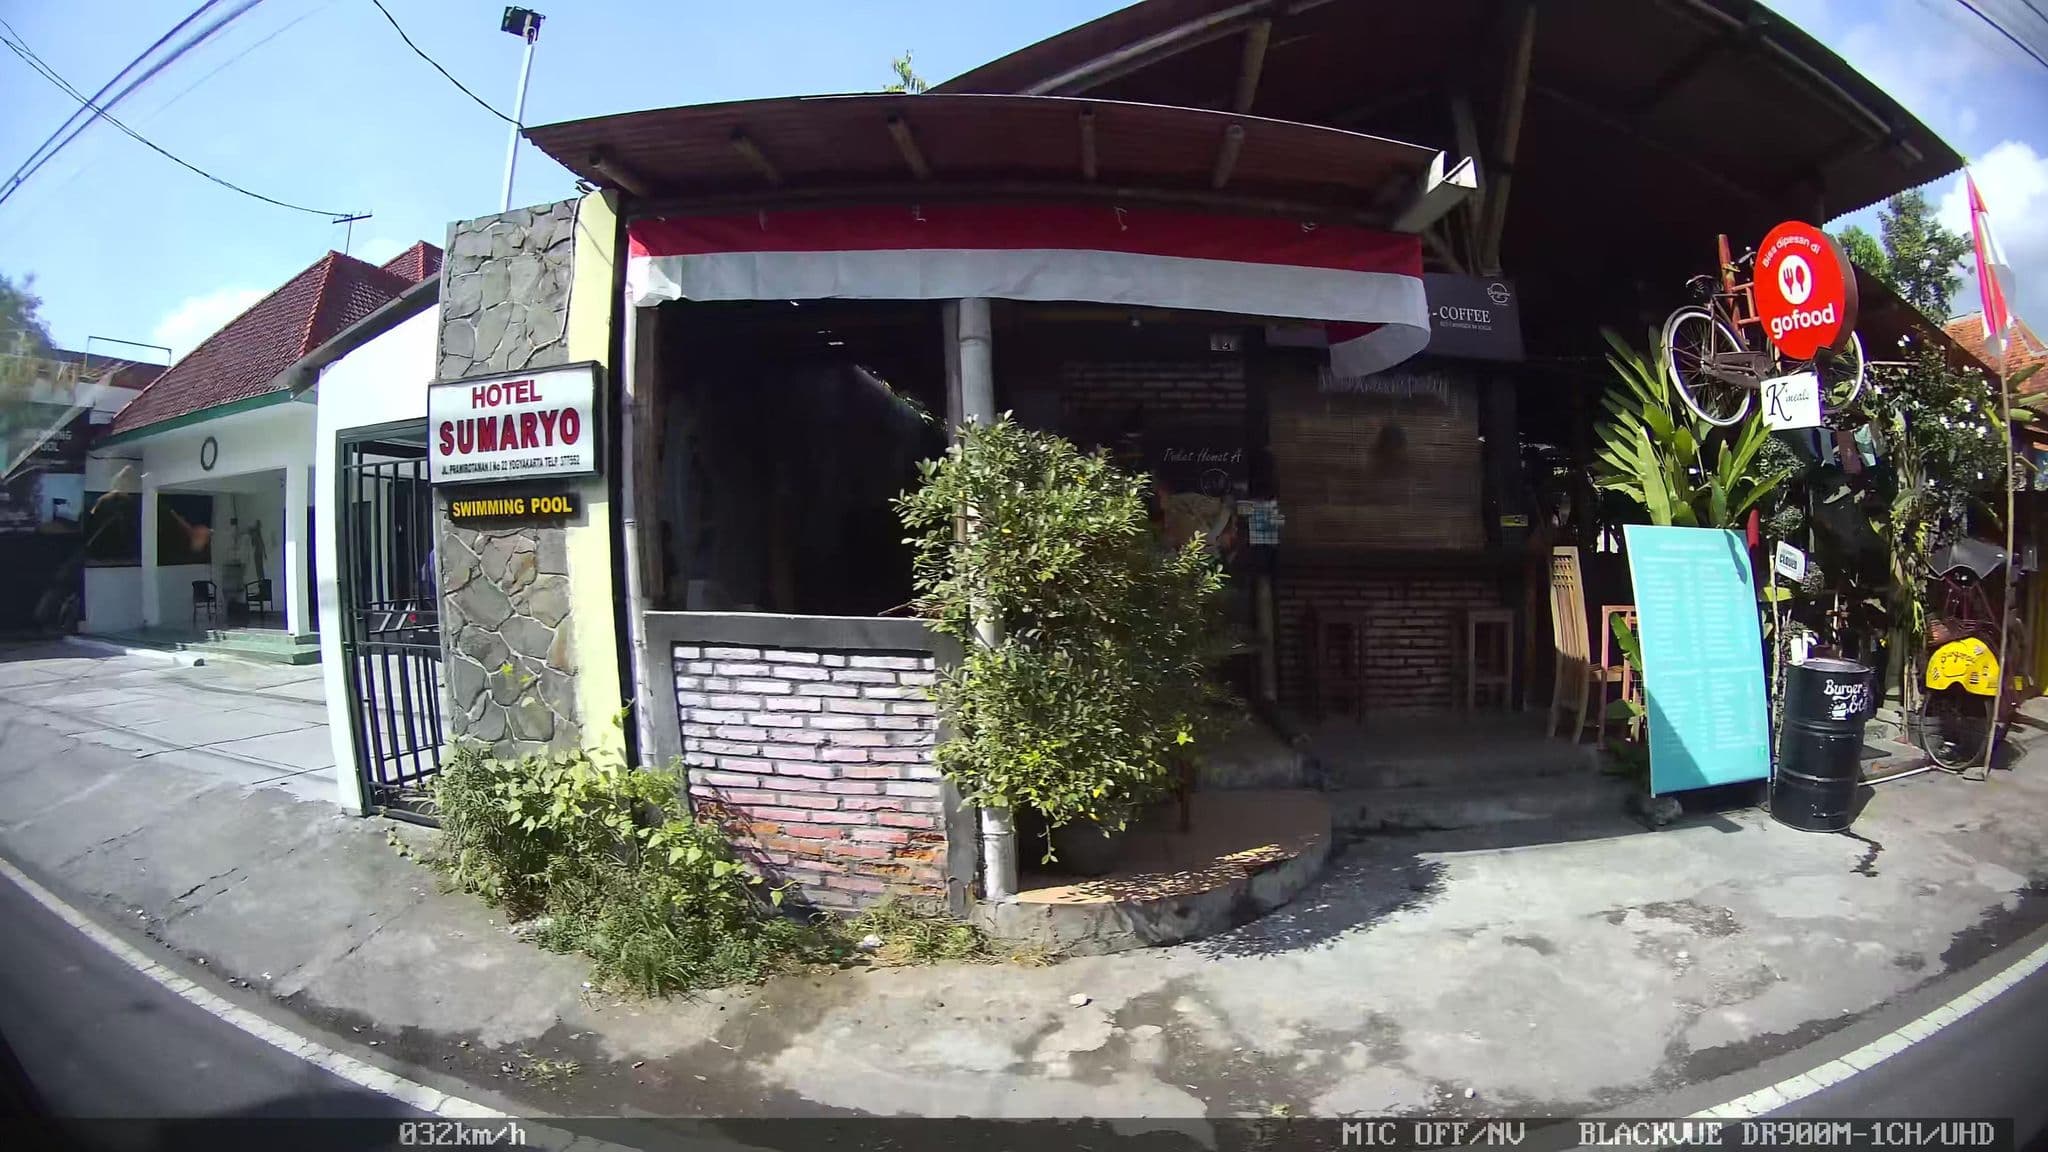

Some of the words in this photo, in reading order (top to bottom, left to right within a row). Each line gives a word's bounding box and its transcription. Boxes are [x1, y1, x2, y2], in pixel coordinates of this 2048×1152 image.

[1810, 243, 1821, 255] di
[1439, 305, 1491, 323] COFFEE
[1771, 302, 1835, 339] gofood
[472, 379, 543, 409] HOTEL
[439, 407, 581, 456] SUMARYO
[509, 458, 543, 470] YOGYAKARTA
[452, 498, 525, 517] SWIMMING
[531, 496, 573, 513] POOL
[1824, 679, 1863, 701] Burger
